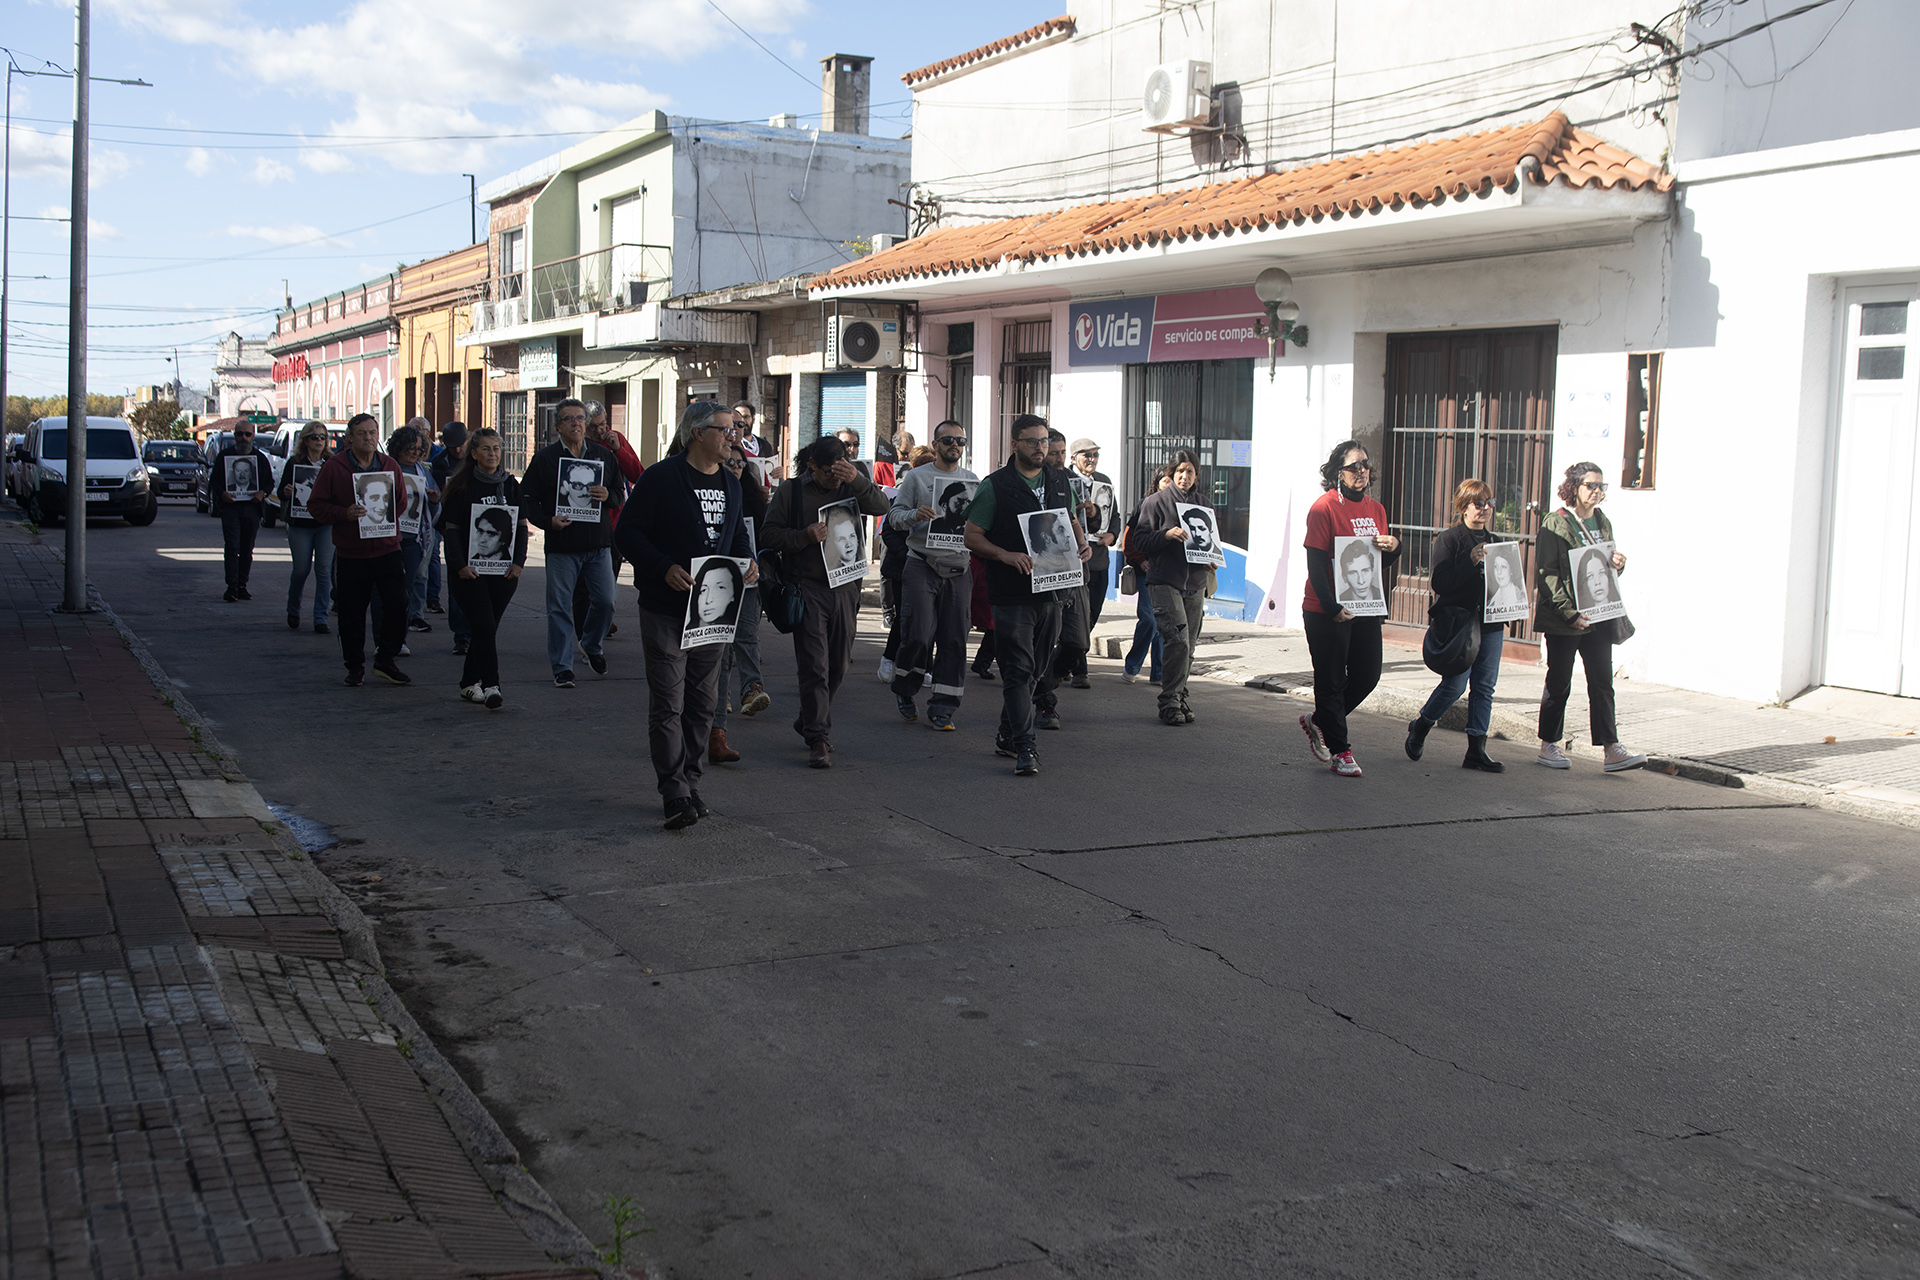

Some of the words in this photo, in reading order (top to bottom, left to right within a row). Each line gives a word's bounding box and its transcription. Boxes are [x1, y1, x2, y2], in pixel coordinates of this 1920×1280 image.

[1096, 311, 1142, 348] Vida
[693, 489, 726, 501] TODOS
[572, 508, 599, 516] ESCUDERO
[400, 520, 419, 528] GÓMEZ
[1350, 517, 1376, 528] TODOS
[361, 524, 376, 532] ENRIQUE
[1353, 526, 1380, 537] SOMOS
[928, 534, 951, 542] NATALIO
[952, 535, 964, 543] DER
[1186, 550, 1208, 558] FERNANDO
[828, 571, 841, 580] ELSA
[1033, 574, 1056, 585] JÚPITER
[1057, 571, 1082, 581] DELPINO
[1355, 601, 1385, 609] BENTANCOUR
[1485, 606, 1508, 615] BLANCA
[703, 624, 735, 636] GRINSPÓN
